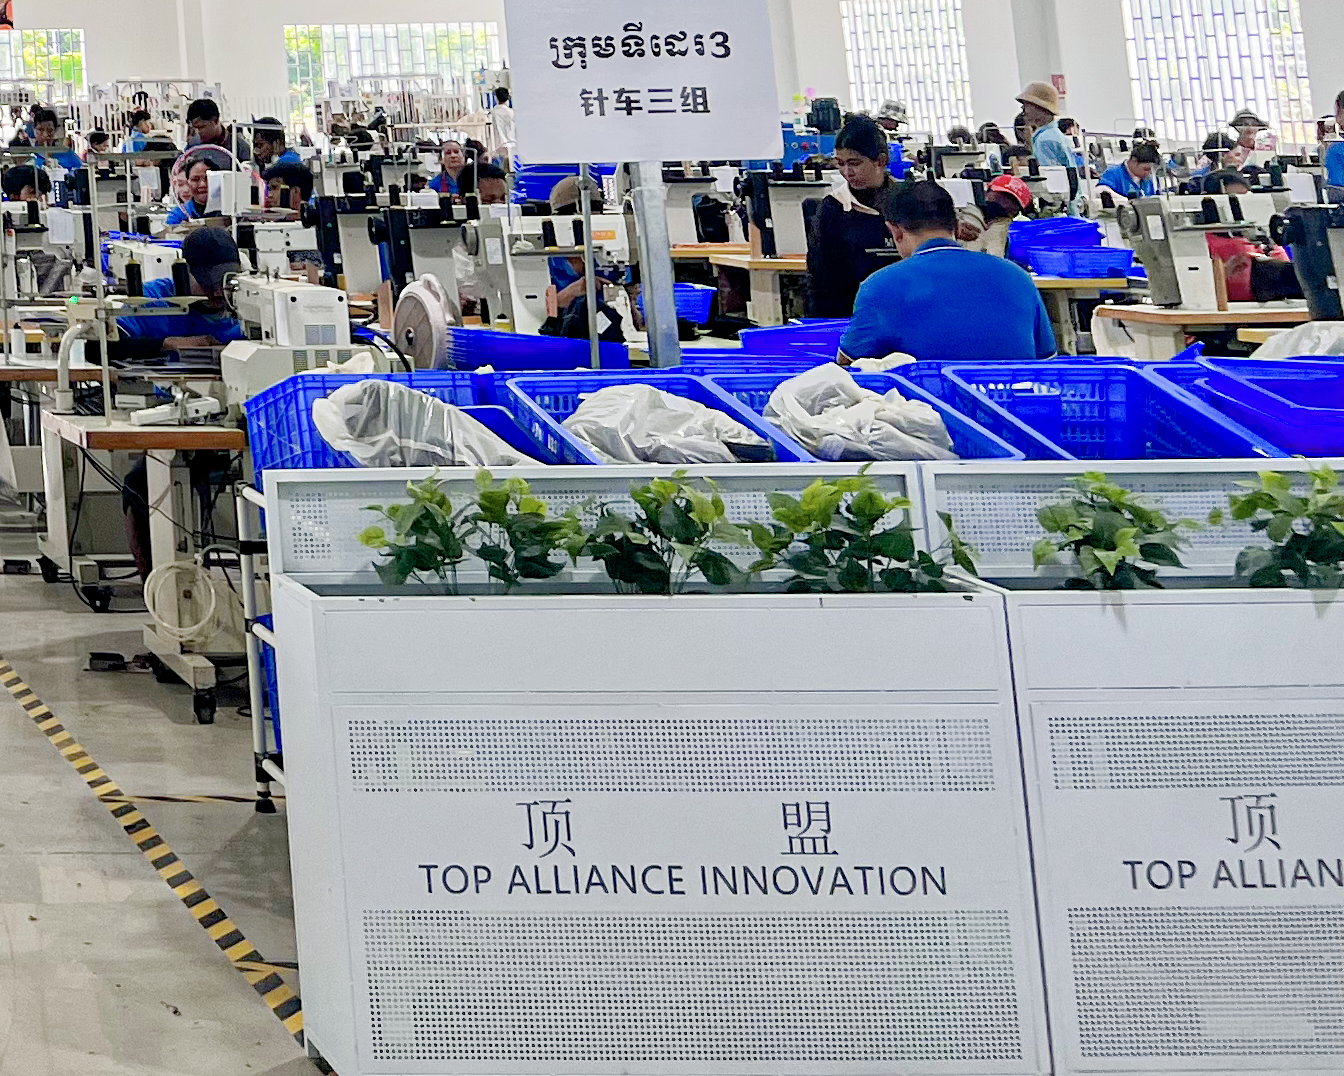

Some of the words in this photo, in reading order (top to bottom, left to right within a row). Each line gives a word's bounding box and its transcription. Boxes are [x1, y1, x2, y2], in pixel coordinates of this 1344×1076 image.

[579, 85, 712, 117] 针车三组
[515, 797, 576, 859] 顶
[780, 800, 839, 856] 盟
[1218, 792, 1282, 853] 顶
[417, 864, 492, 895] TOP
[507, 864, 686, 896] ALLIANCE
[700, 865, 948, 896] INNOVATION
[1121, 859, 1197, 890] TOP
